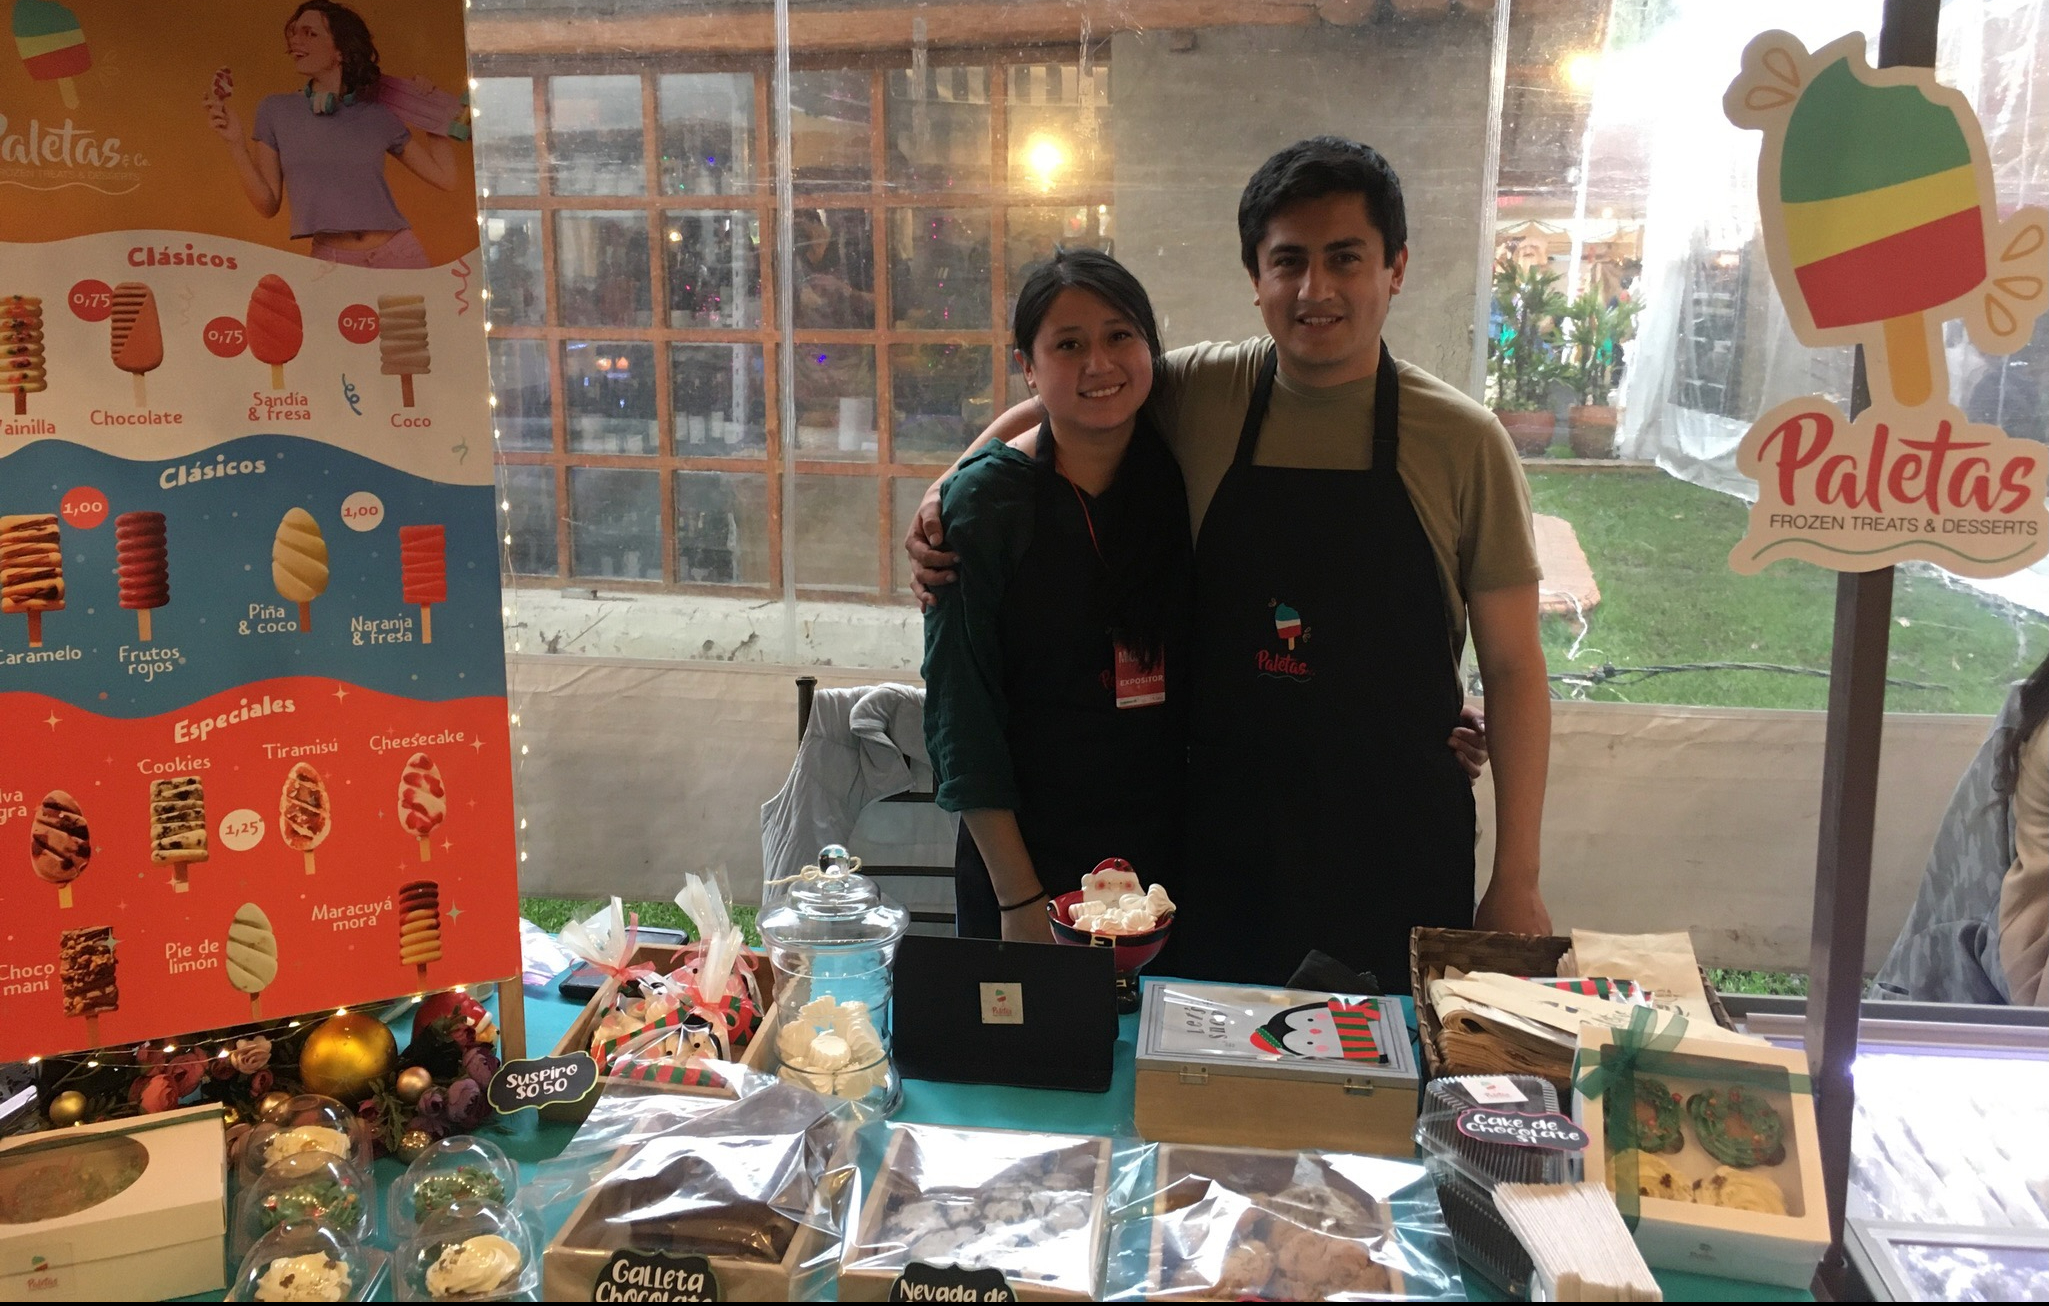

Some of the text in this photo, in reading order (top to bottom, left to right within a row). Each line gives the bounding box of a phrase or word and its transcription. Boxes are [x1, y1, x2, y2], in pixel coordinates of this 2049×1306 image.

[0, 113, 121, 168] aletas
[128, 243, 238, 270] Clásicos
[73, 293, 110, 308] 0,75
[343, 317, 376, 331] 0,75
[208, 330, 243, 344] 0,75
[253, 392, 308, 408] Sandía
[90, 410, 183, 426] Chocolate
[248, 404, 311, 421] & fresa
[390, 414, 431, 428] Coco
[0, 419, 56, 435] ainilla
[159, 454, 266, 489] Clásicos
[1757, 412, 2036, 515] Paletas
[63, 501, 103, 517] 1,00
[343, 505, 379, 519] 1,00
[1769, 513, 2038, 536] FROZEN TREATS & DESSERTS
[248, 604, 285, 619] Piña
[238, 620, 297, 635] & coco
[350, 613, 413, 634] Naranja
[352, 630, 413, 645] & fresa
[119, 646, 180, 662] Frutos
[1255, 650, 1307, 675] Paletas
[128, 659, 173, 682] rojos
[1119, 675, 1164, 687] EXPOSITOR
[174, 696, 296, 744] Especiales
[262, 738, 338, 760] Tiramisú
[369, 730, 464, 751] Cheesecake
[138, 755, 211, 774] Cookies
[224, 820, 259, 837] 1,25
[311, 896, 392, 921] Maracuyá
[333, 914, 377, 931] mora
[165, 939, 219, 959] Pie de
[0, 963, 55, 981] Choco
[169, 954, 218, 974] limón
[3, 975, 50, 996] maní
[1473, 1113, 1557, 1131] Cake de
[900, 1278, 977, 1302] Nevada
